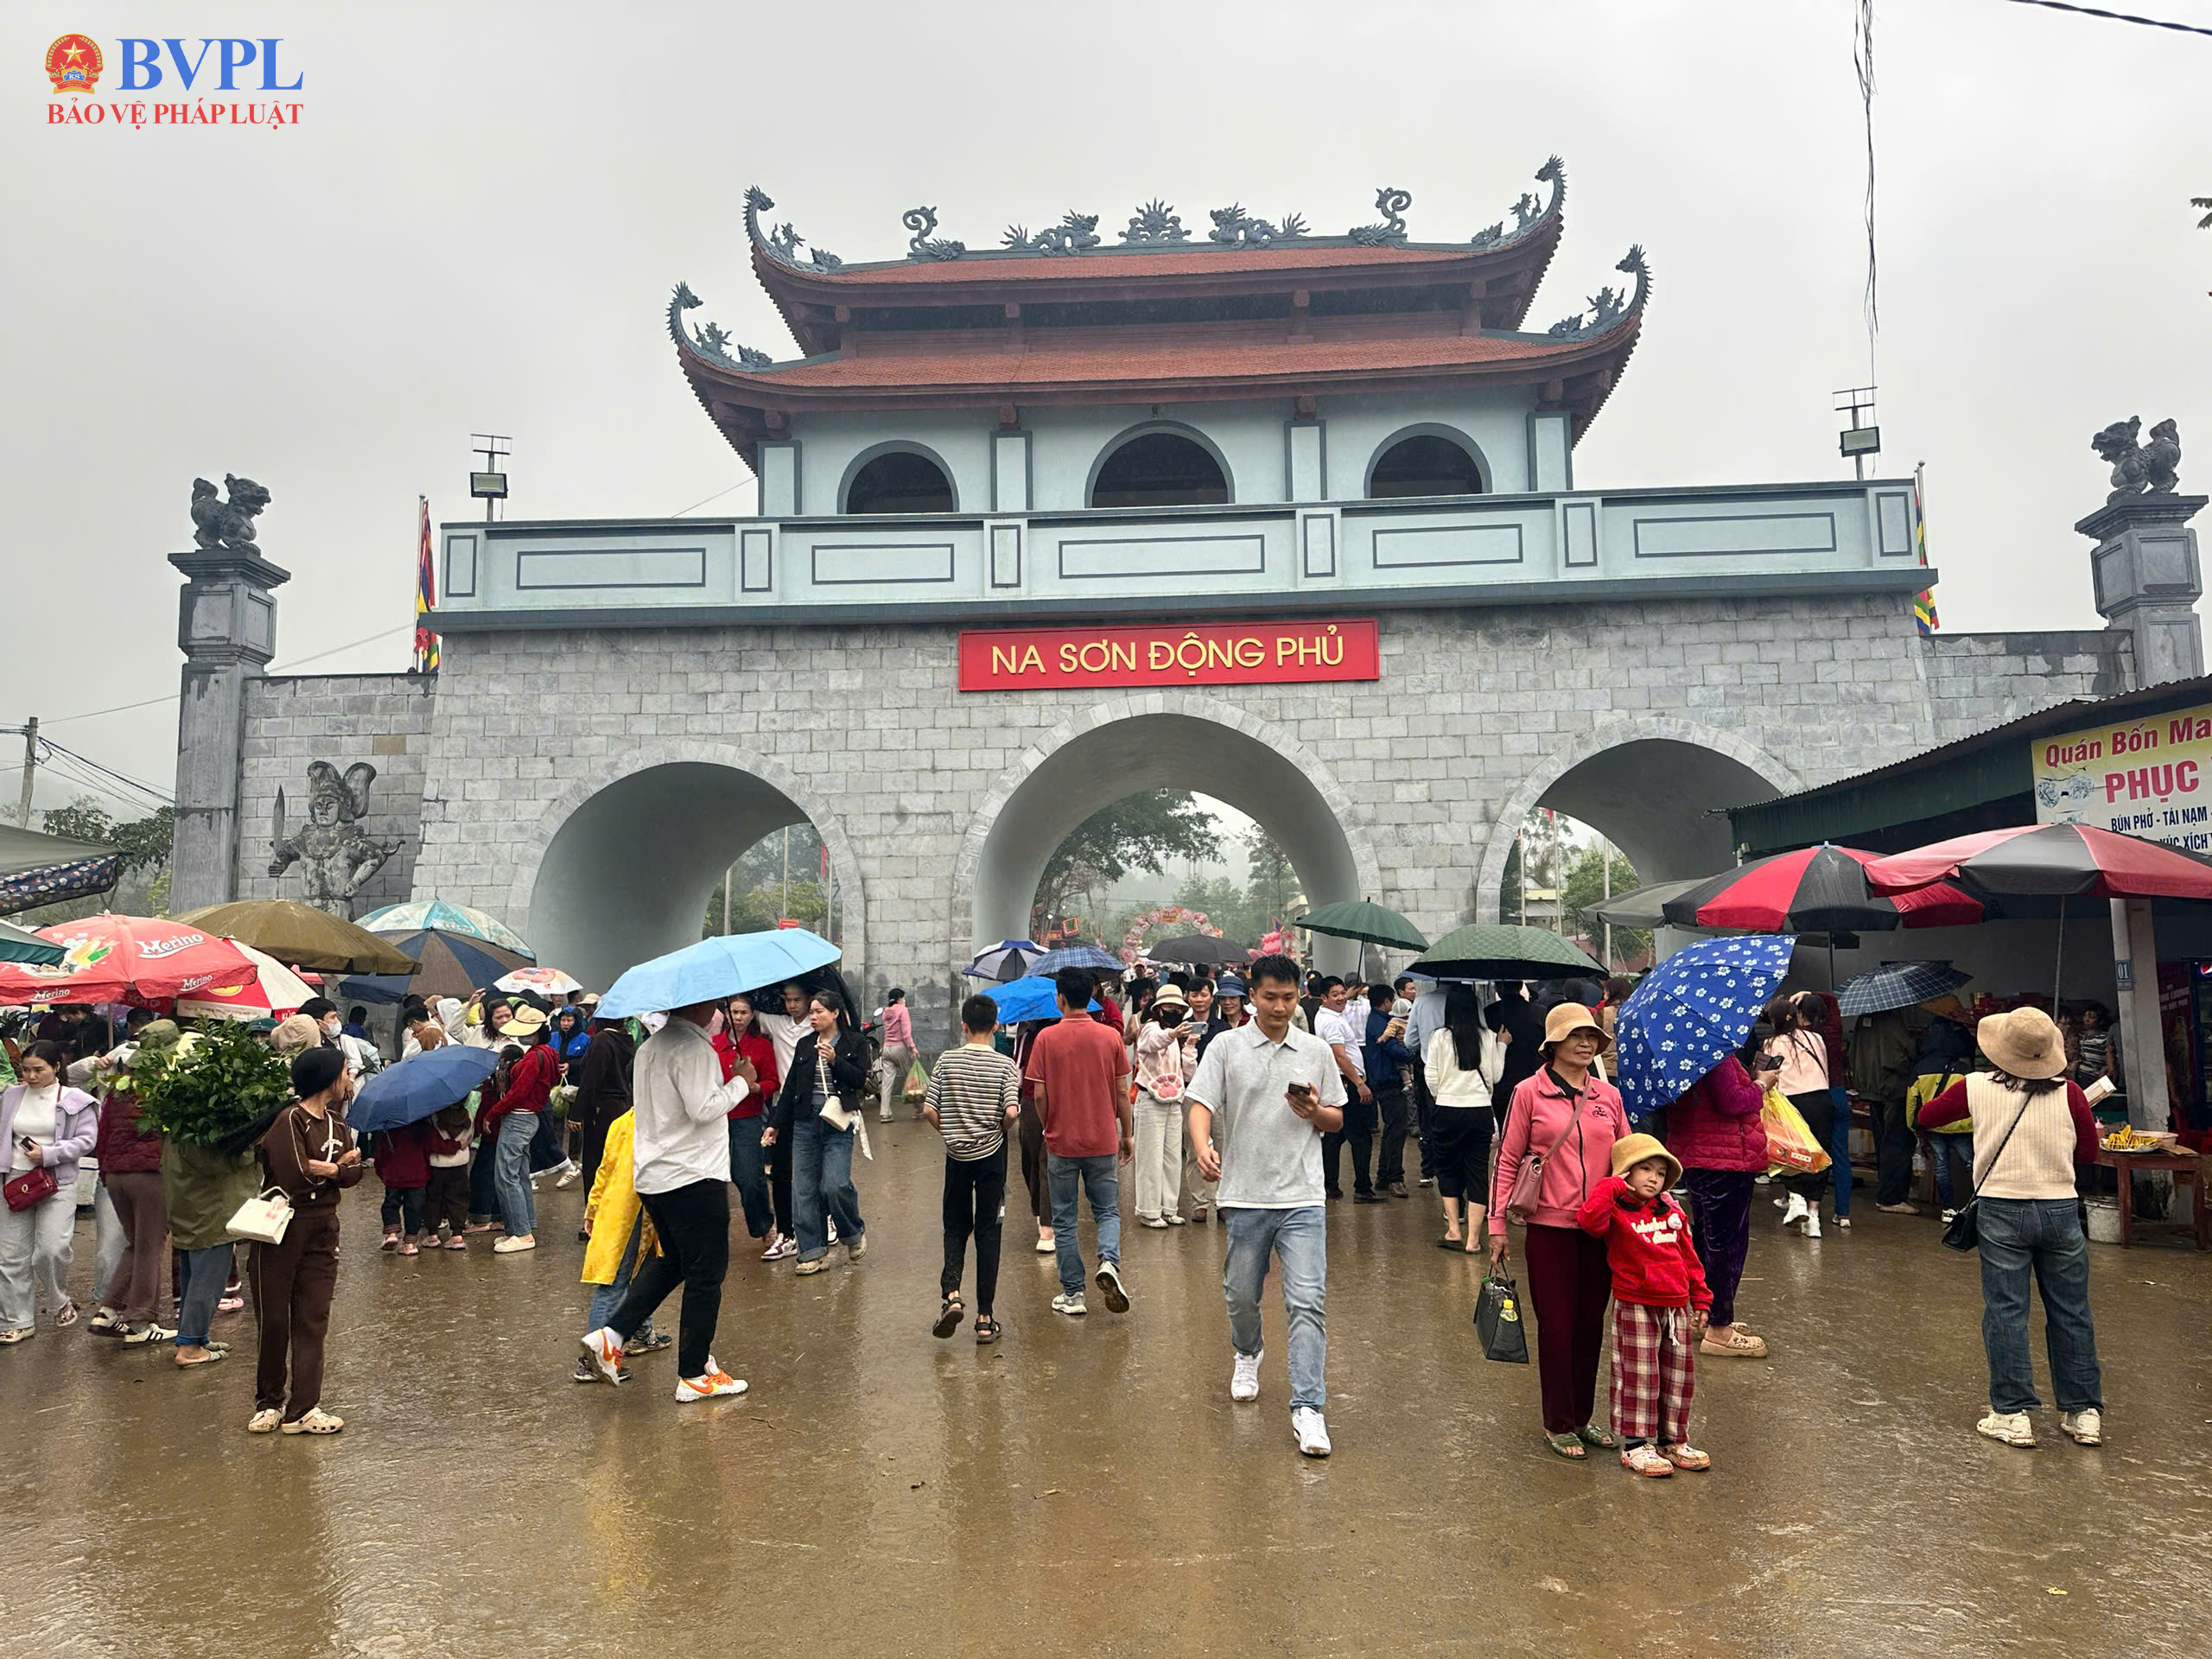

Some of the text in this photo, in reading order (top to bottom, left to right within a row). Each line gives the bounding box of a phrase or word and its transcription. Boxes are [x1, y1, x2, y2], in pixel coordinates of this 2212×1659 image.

[991, 624, 1344, 677] NA SƠN ĐỘNG PHỦ
[2045, 738, 2102, 768] Quán
[2111, 721, 2158, 755] Bốn
[2104, 760, 2200, 804] PHỤC
[2111, 814, 2132, 832] BÚN
[2133, 806, 2154, 830] PHỞ
[2162, 807, 2179, 826] TÁI
[2182, 805, 2208, 827] NẠM
[134, 933, 205, 957] Merino
[182, 974, 213, 990] Merino
[2118, 963, 2129, 979] 01
[34, 988, 71, 1001] Merino
